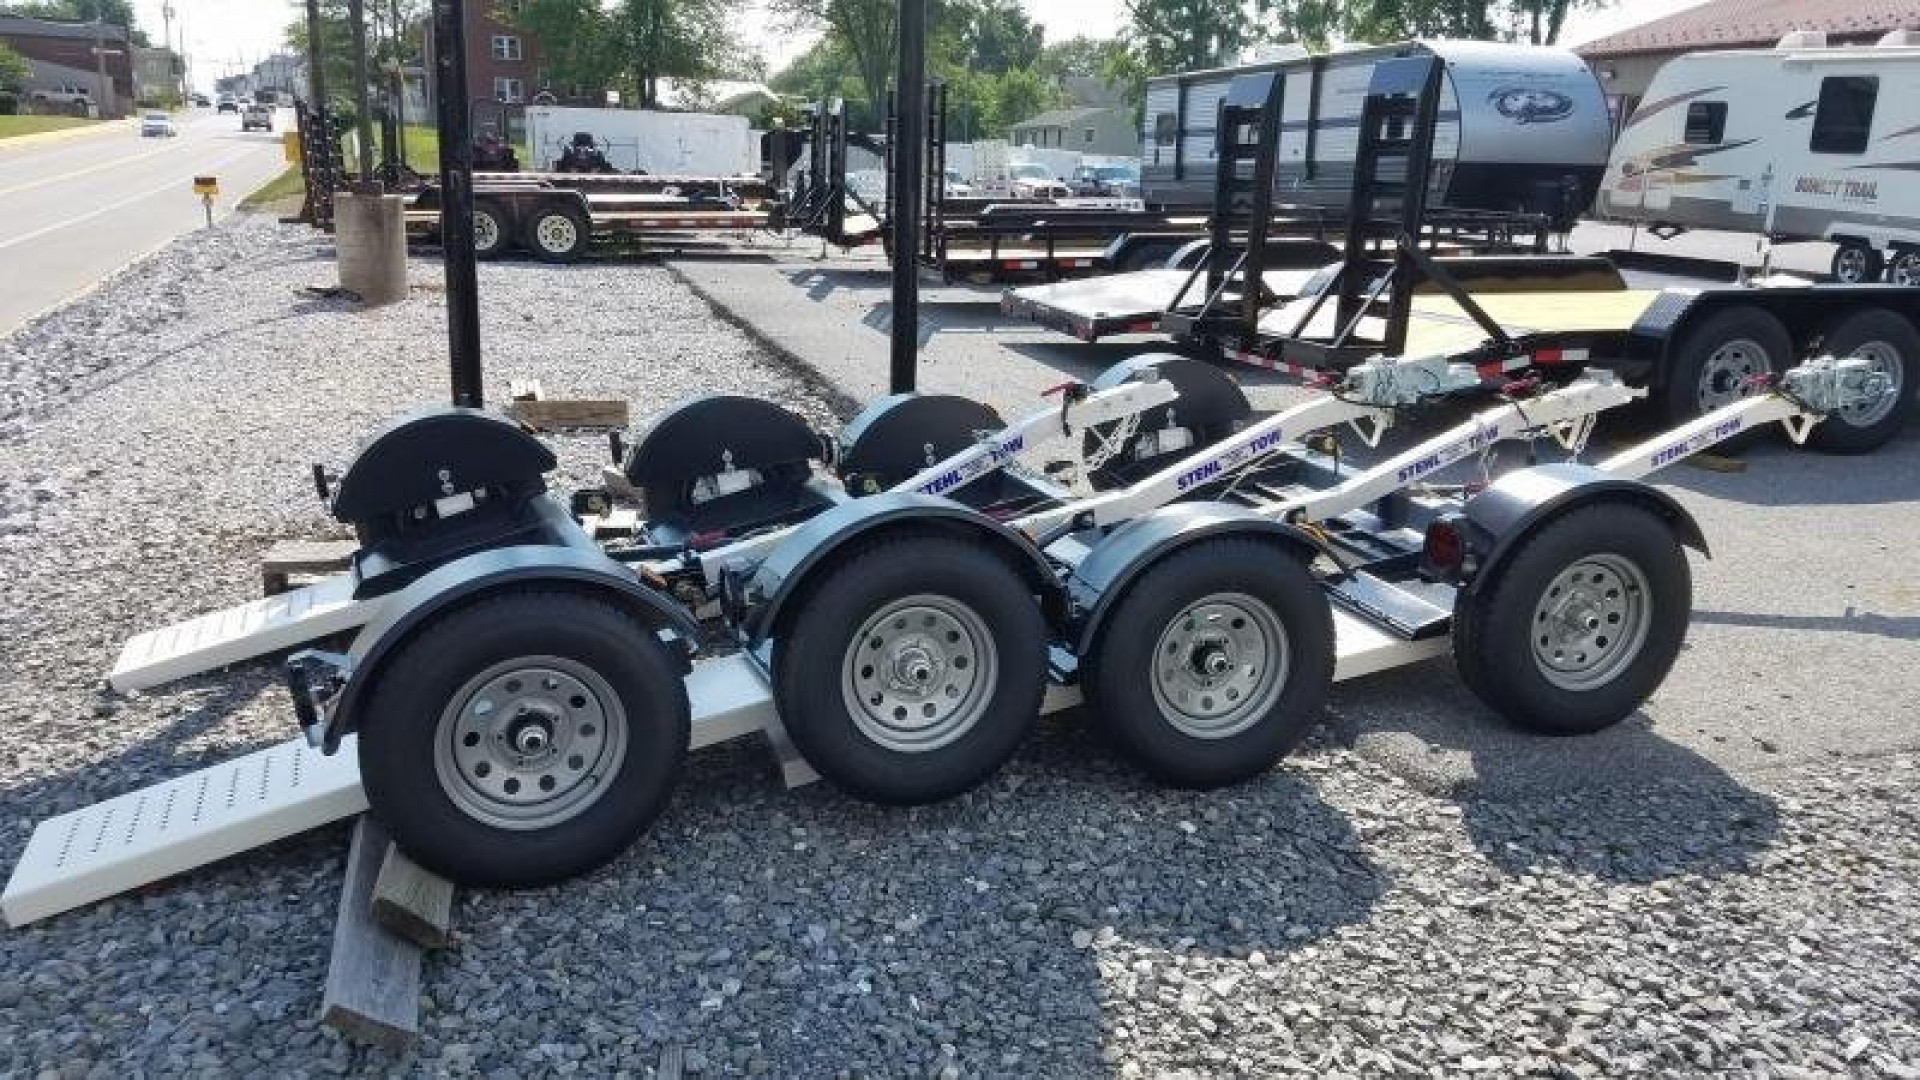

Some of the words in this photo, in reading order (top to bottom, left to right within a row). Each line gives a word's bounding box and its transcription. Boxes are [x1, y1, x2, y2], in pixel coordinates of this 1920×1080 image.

[989, 434, 1023, 462] TOW
[1177, 460, 1222, 490] STEHL
[1250, 428, 1282, 454] TOW
[1651, 441, 1690, 466] STEHL
[1715, 416, 1743, 438] TOW
[1398, 453, 1440, 482] STEHL
